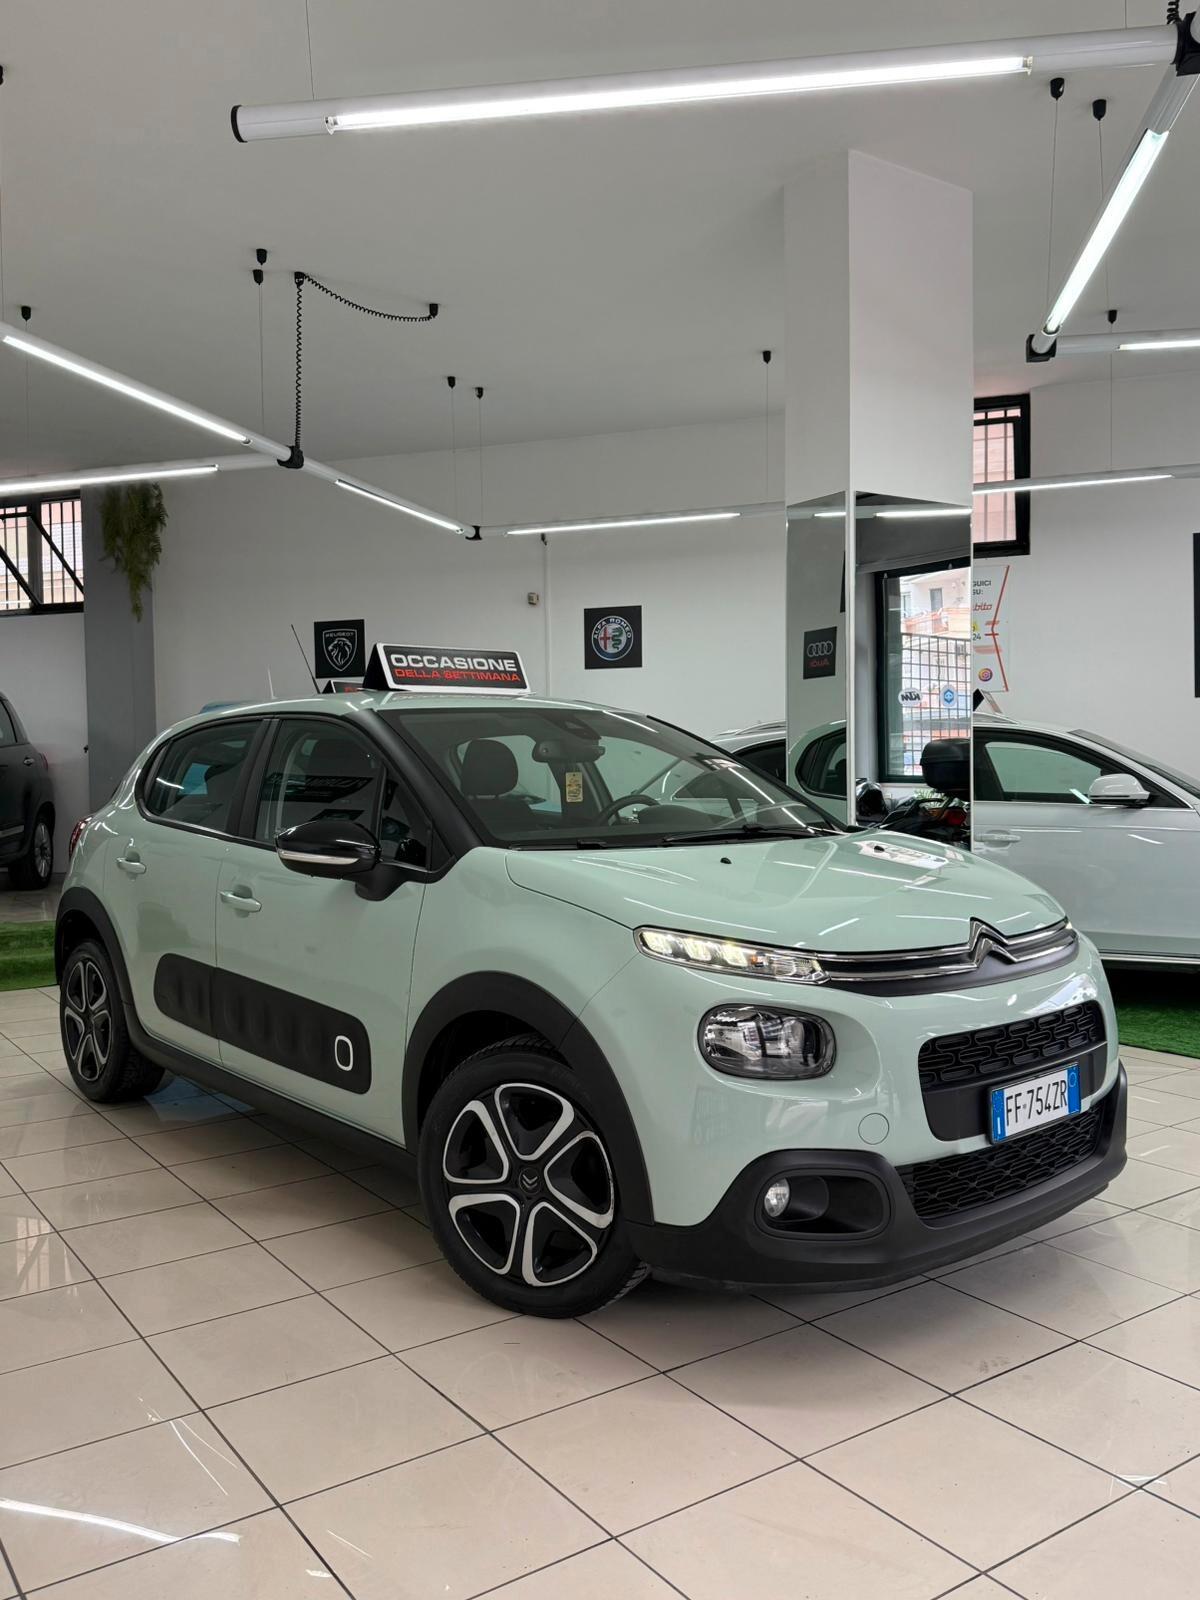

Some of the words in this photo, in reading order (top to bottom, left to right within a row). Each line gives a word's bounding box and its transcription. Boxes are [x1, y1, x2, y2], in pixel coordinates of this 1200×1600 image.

[594, 621, 607, 639] ALFA
[609, 618, 632, 639] ROMEO
[390, 654, 517, 671] OCCASIONE
[394, 668, 440, 679] DELLA
[444, 671, 521, 681] SETTIMANA
